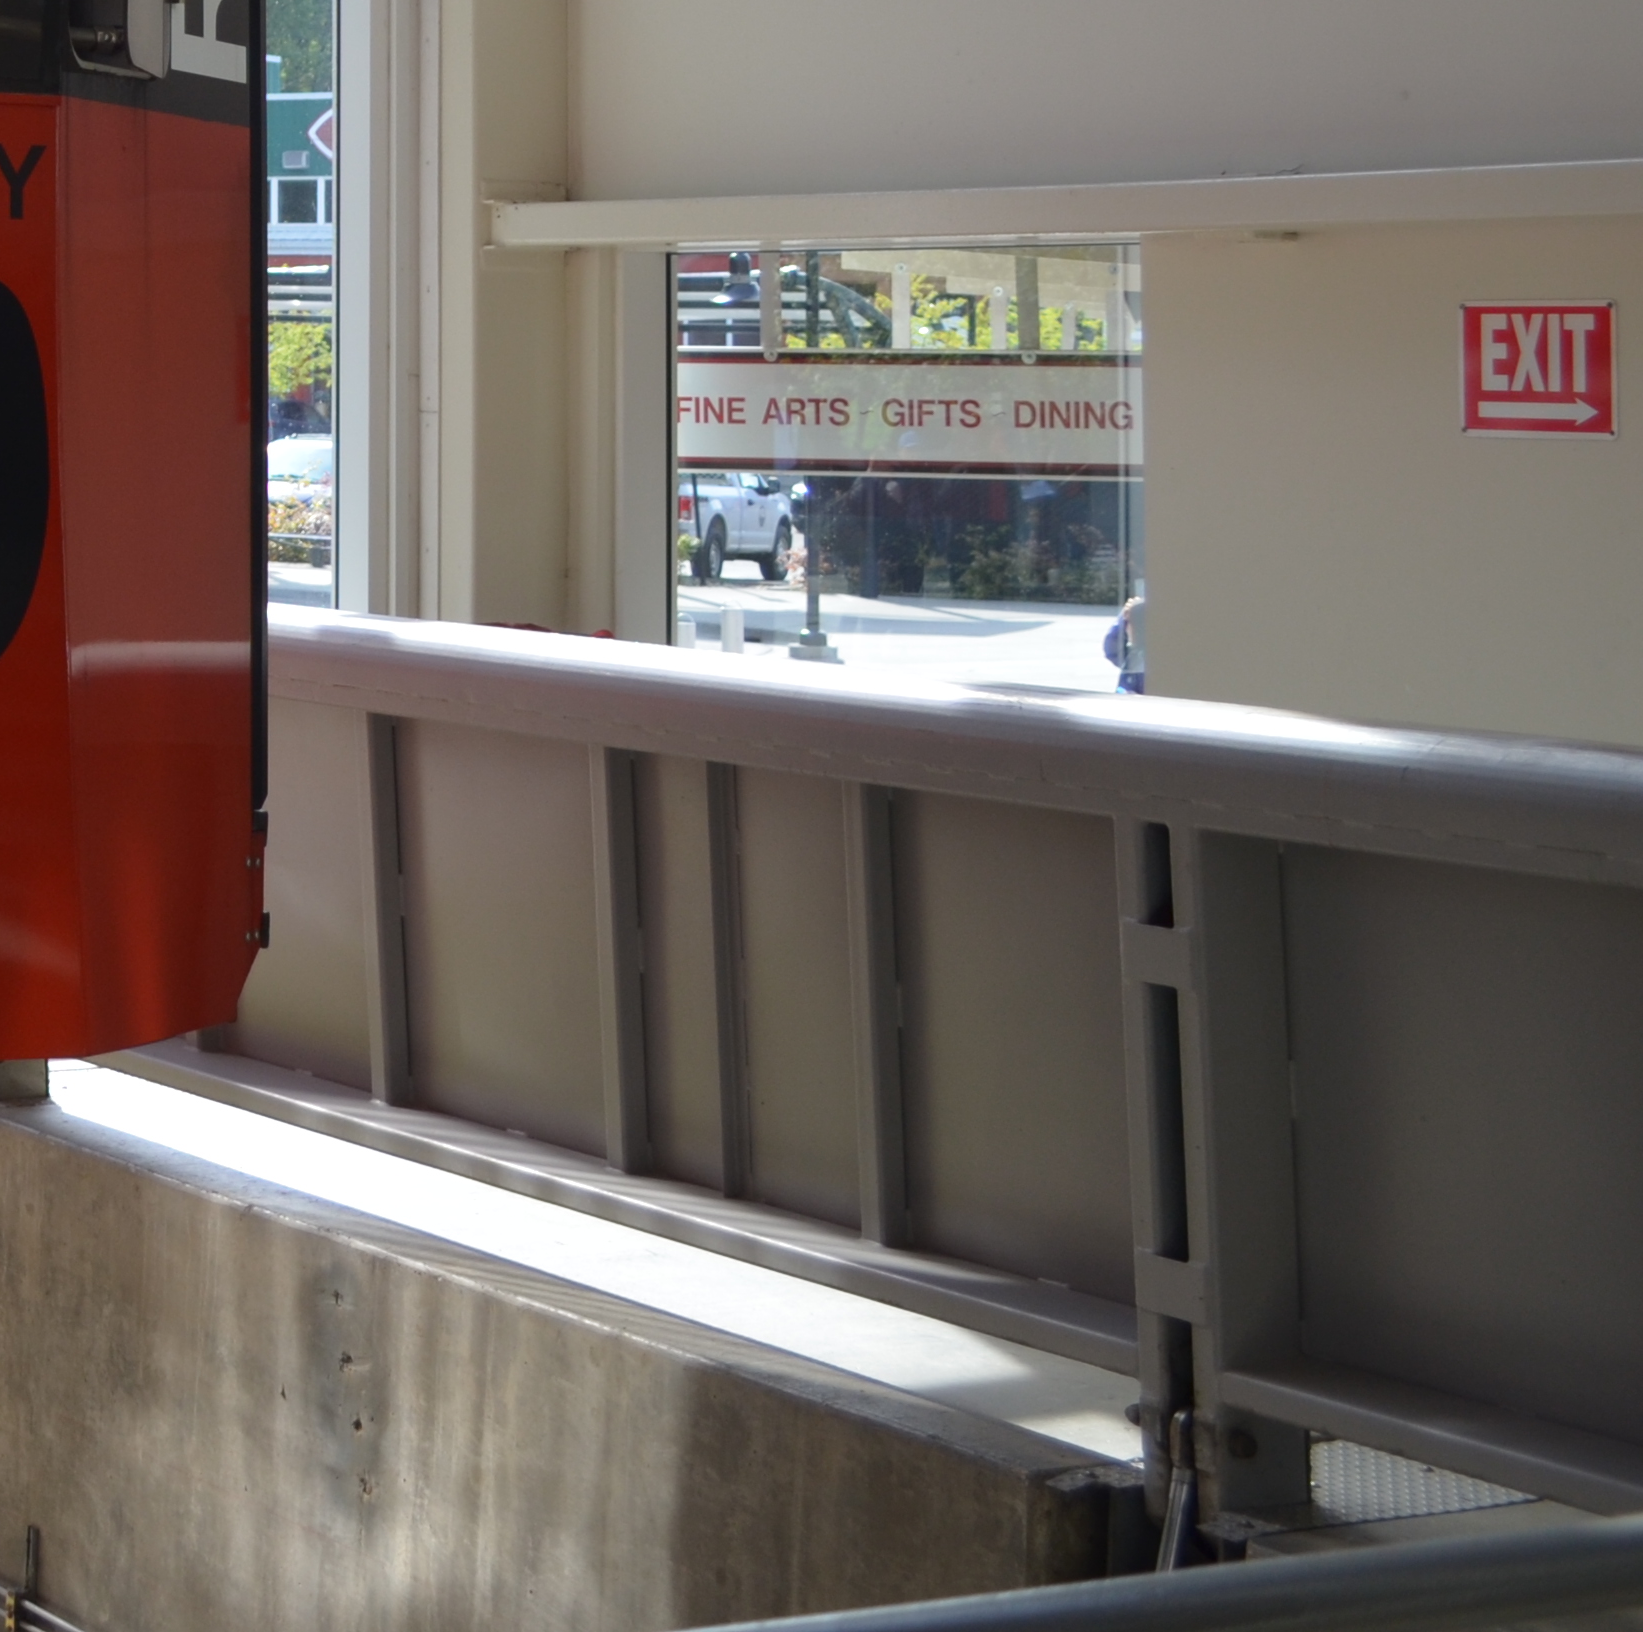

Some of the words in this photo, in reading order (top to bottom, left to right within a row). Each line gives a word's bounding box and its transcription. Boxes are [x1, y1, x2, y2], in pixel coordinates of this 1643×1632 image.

[1480, 312, 1596, 394] EXIT
[676, 396, 747, 426] FINE
[762, 396, 851, 427] ARTS
[881, 398, 982, 429] GIFTS
[1013, 400, 1134, 431] DINING
